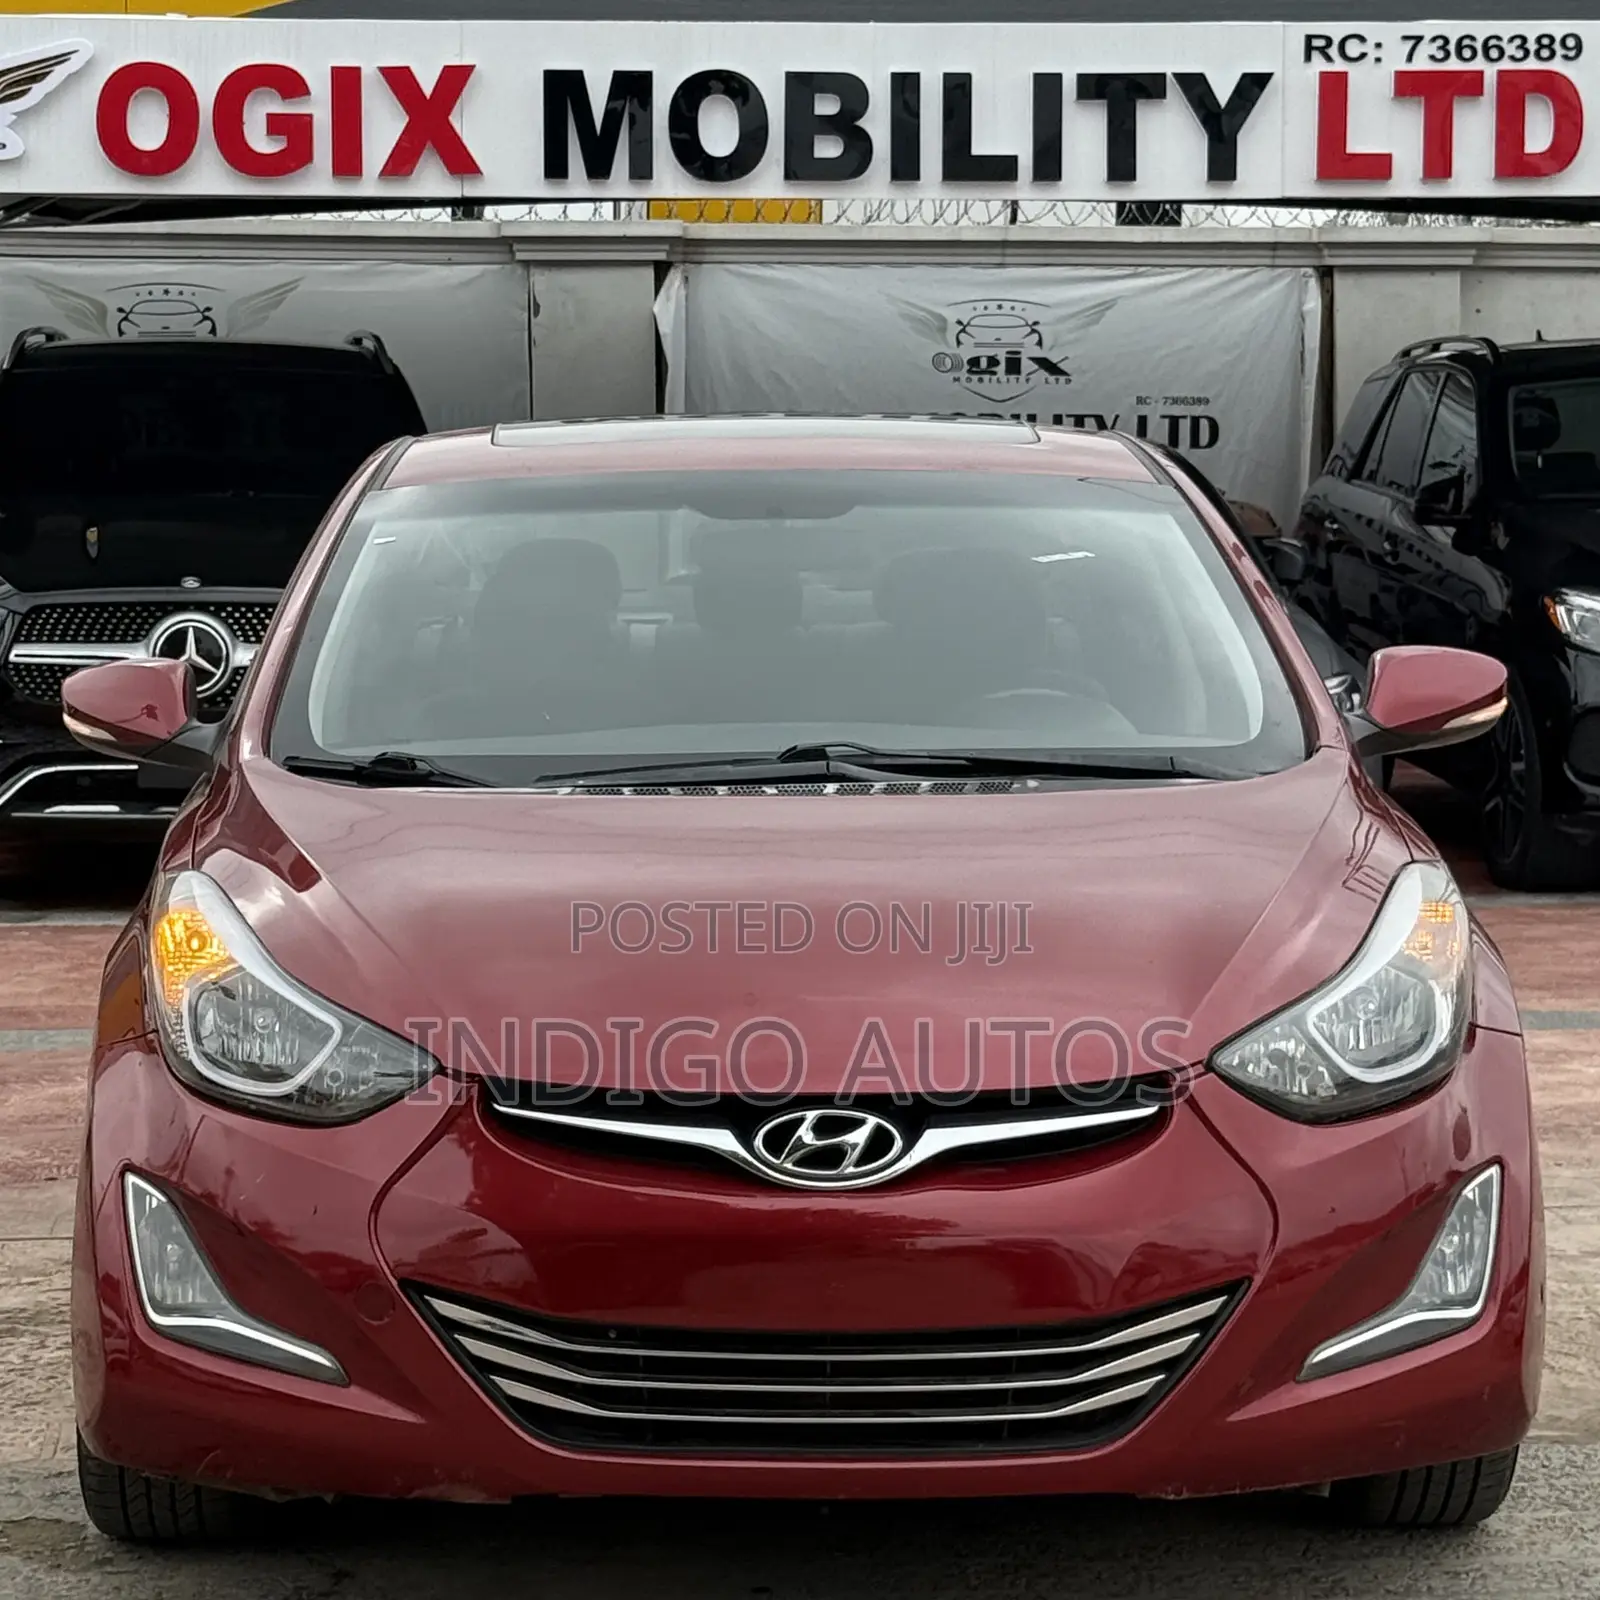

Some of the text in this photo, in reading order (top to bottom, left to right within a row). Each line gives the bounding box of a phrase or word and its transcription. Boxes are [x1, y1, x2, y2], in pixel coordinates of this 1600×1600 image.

[1303, 32, 1584, 64] RC: 7366389
[96, 61, 1585, 184] OGIX MOBILITY LTD
[1043, 376, 1073, 385] LTD
[1135, 395, 1152, 406] RC
